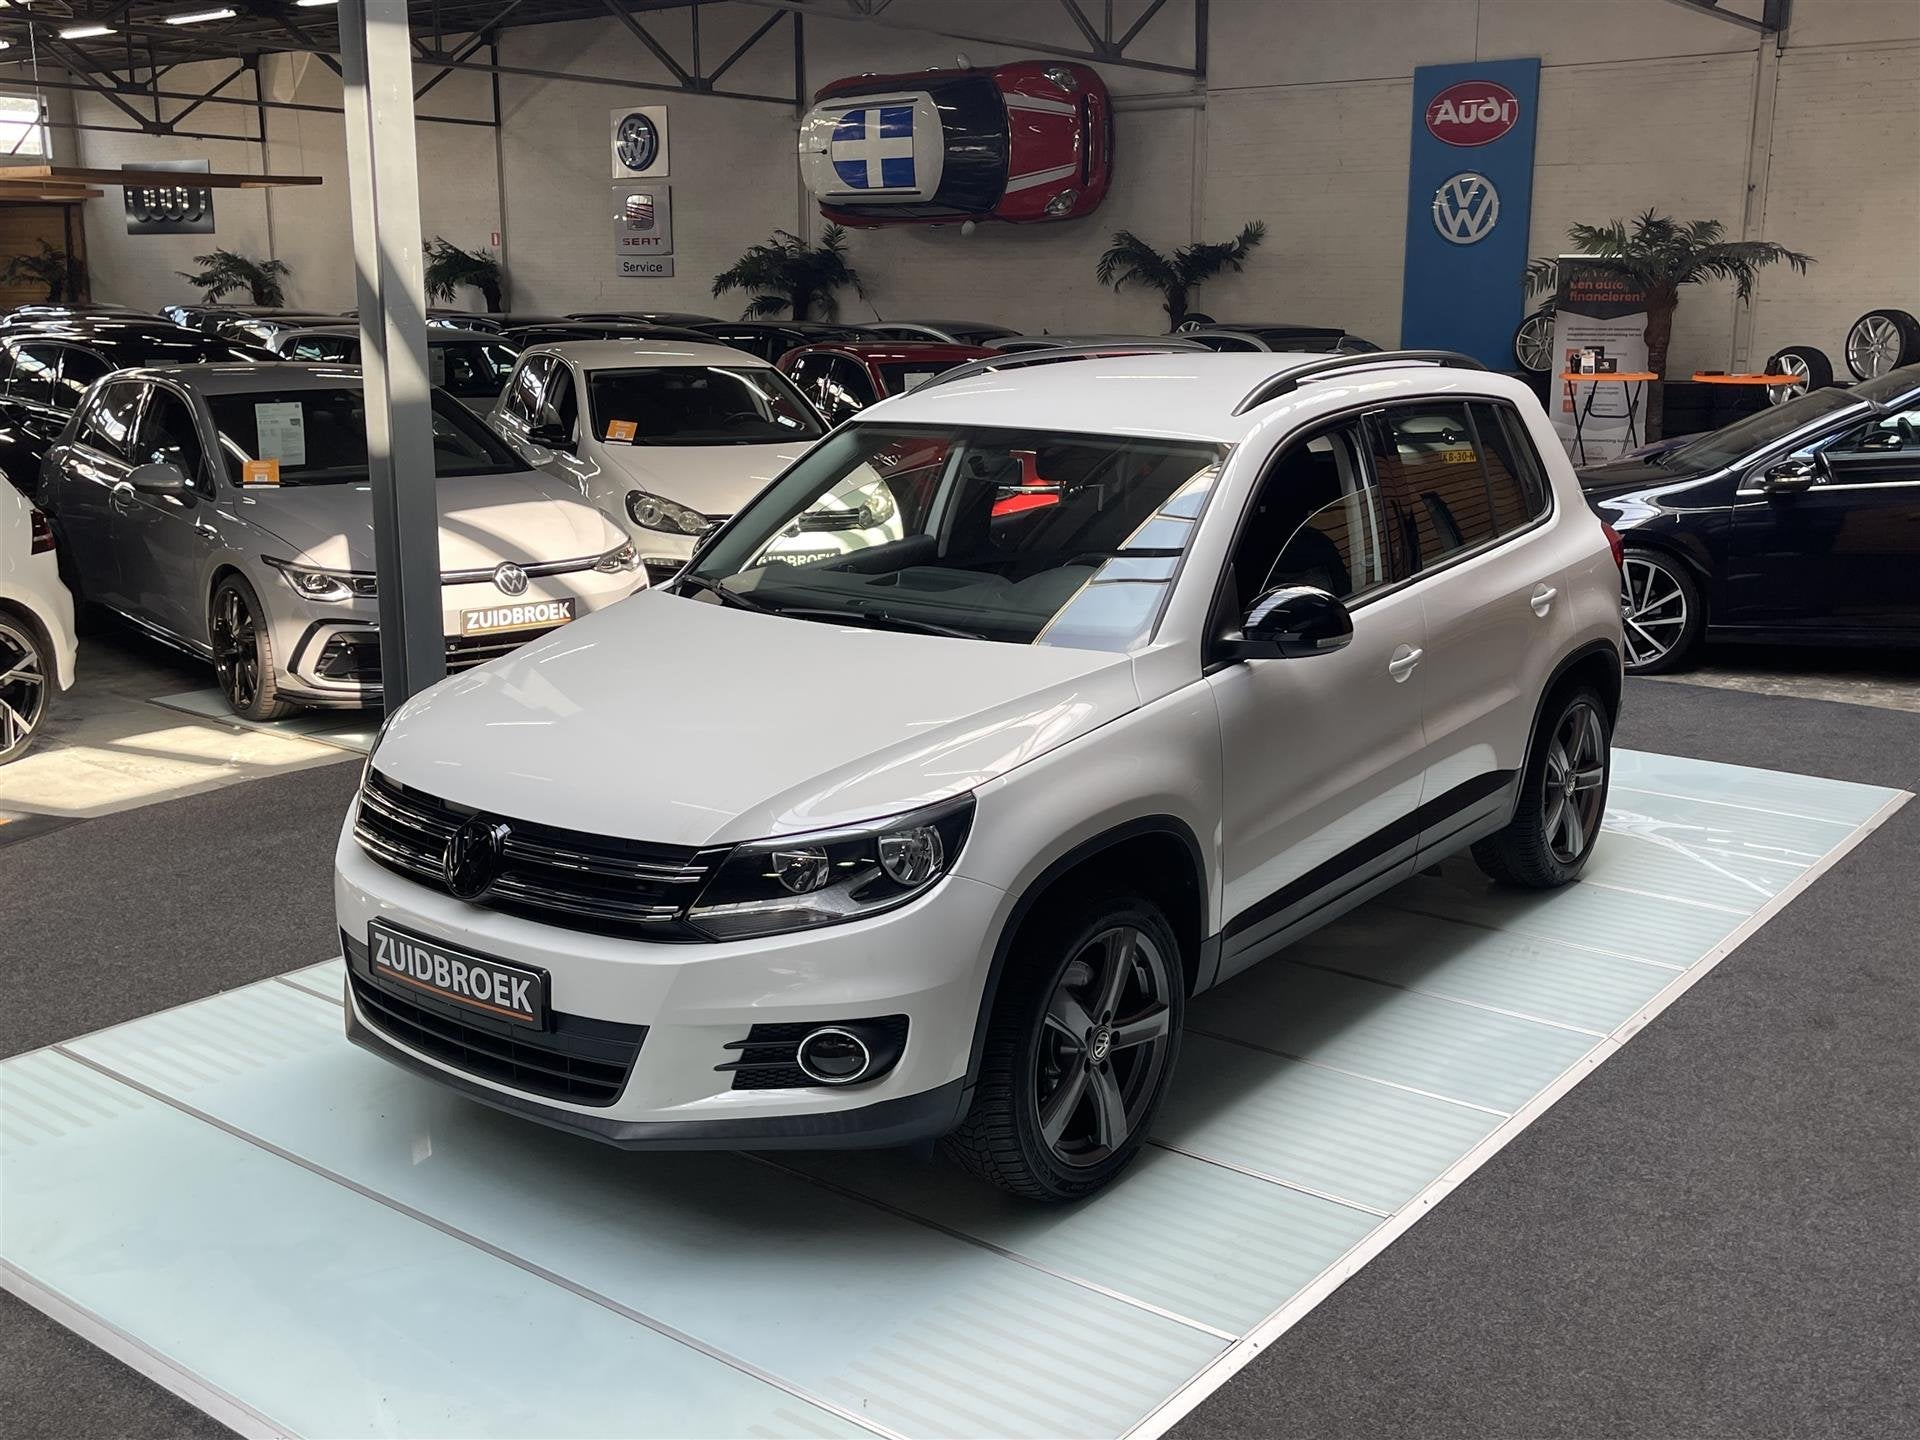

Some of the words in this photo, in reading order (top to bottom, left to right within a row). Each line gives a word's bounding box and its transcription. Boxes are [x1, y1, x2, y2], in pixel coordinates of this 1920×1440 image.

[1433, 96, 1511, 126] Audi
[622, 237, 661, 246] SEAT
[623, 261, 663, 273] Service
[466, 602, 571, 630] ZUIDBROEK
[374, 931, 533, 1014] ZUIDBROEK
